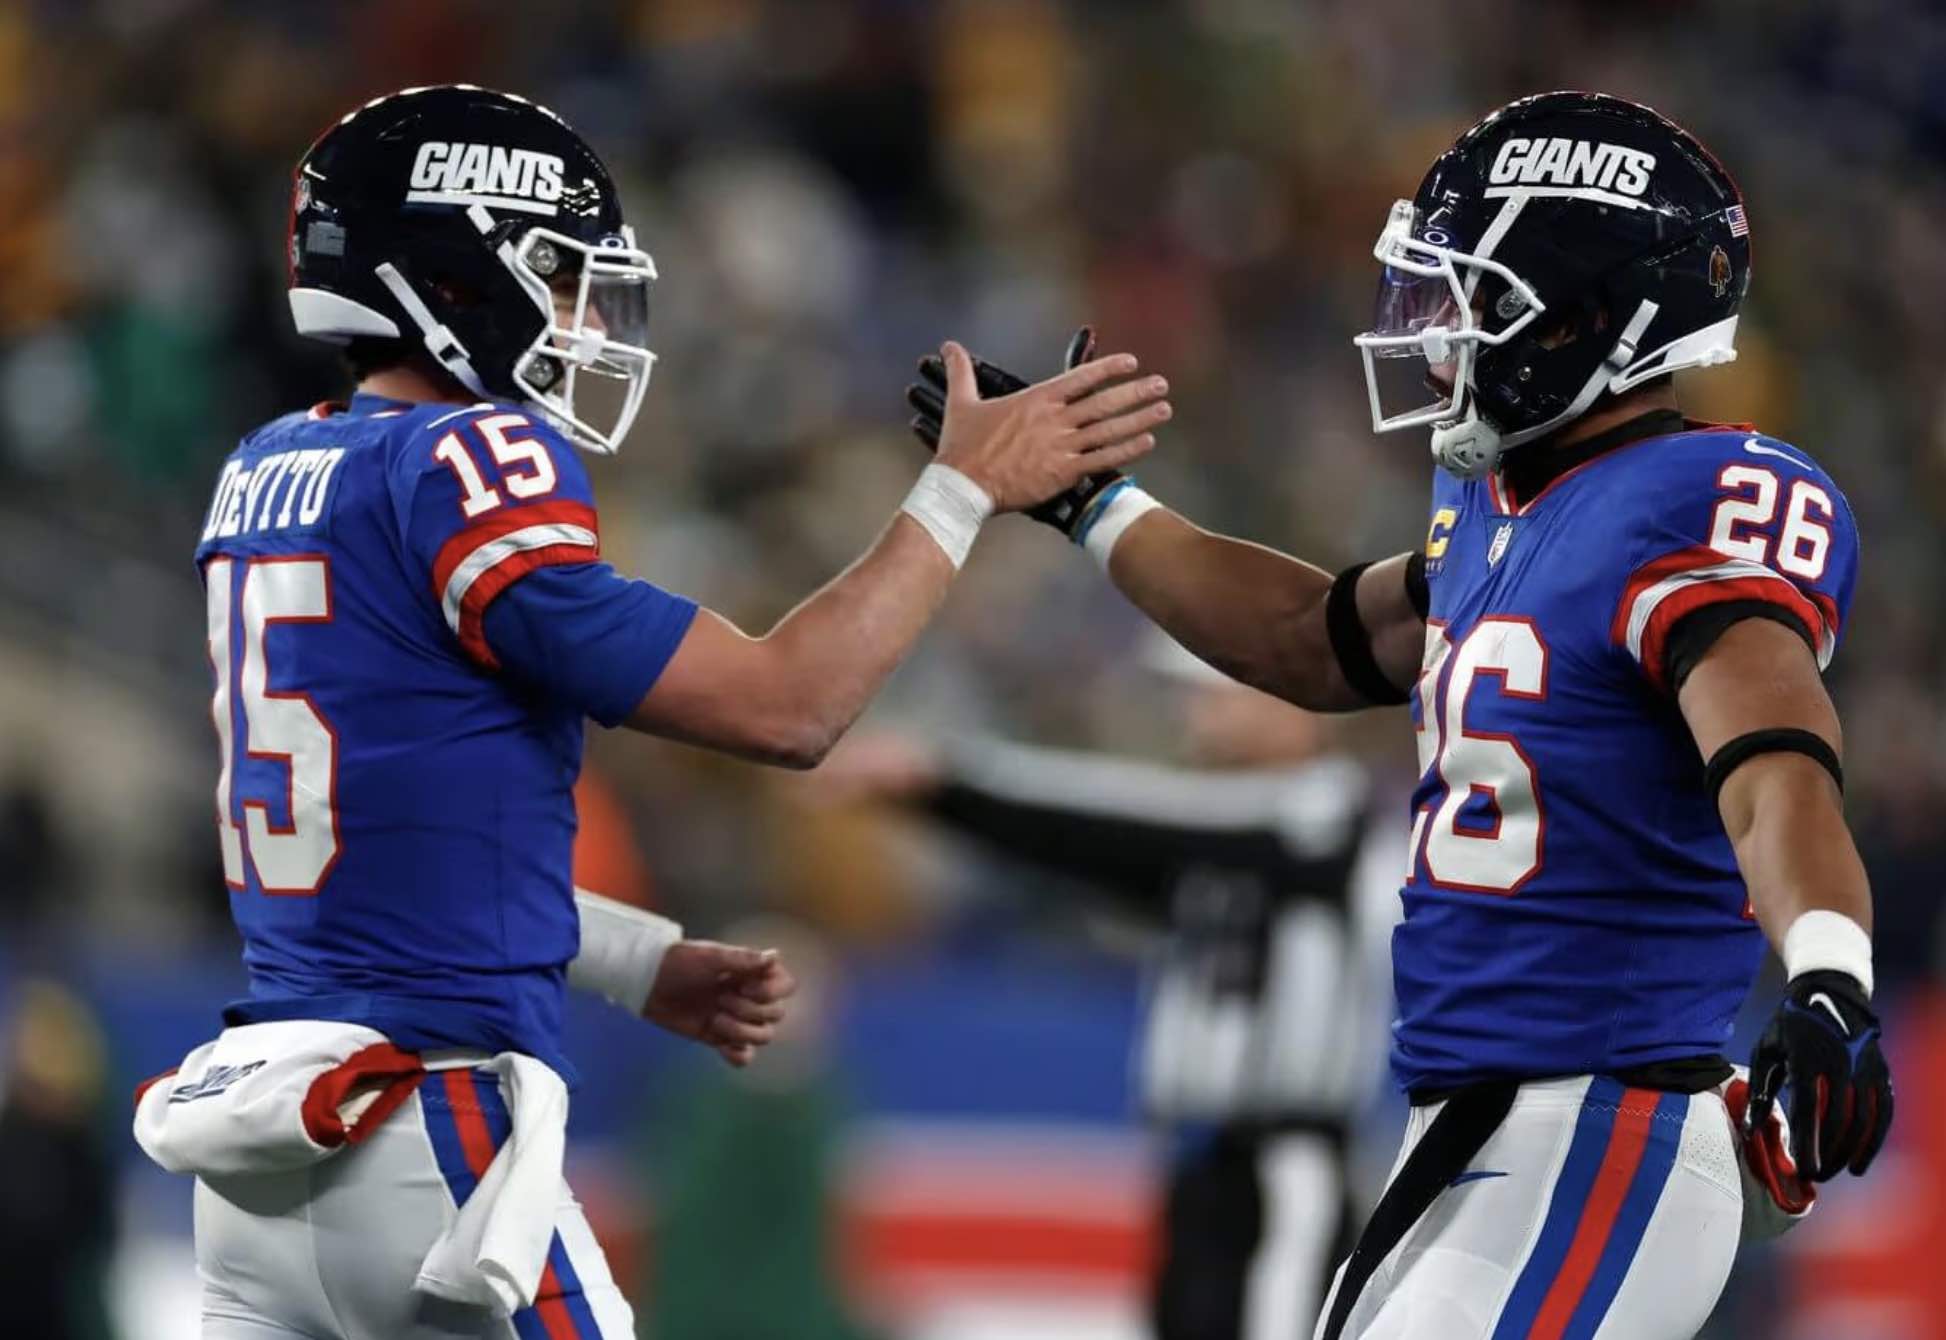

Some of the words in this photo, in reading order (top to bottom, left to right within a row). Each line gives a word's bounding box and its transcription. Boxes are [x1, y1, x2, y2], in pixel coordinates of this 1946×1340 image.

[409, 141, 565, 201] GIANTS
[1489, 137, 1657, 196] GIANTS
[433, 412, 560, 520] 15
[1425, 508, 1458, 559] C
[1708, 460, 1834, 584] 26
[205, 553, 344, 896] 15
